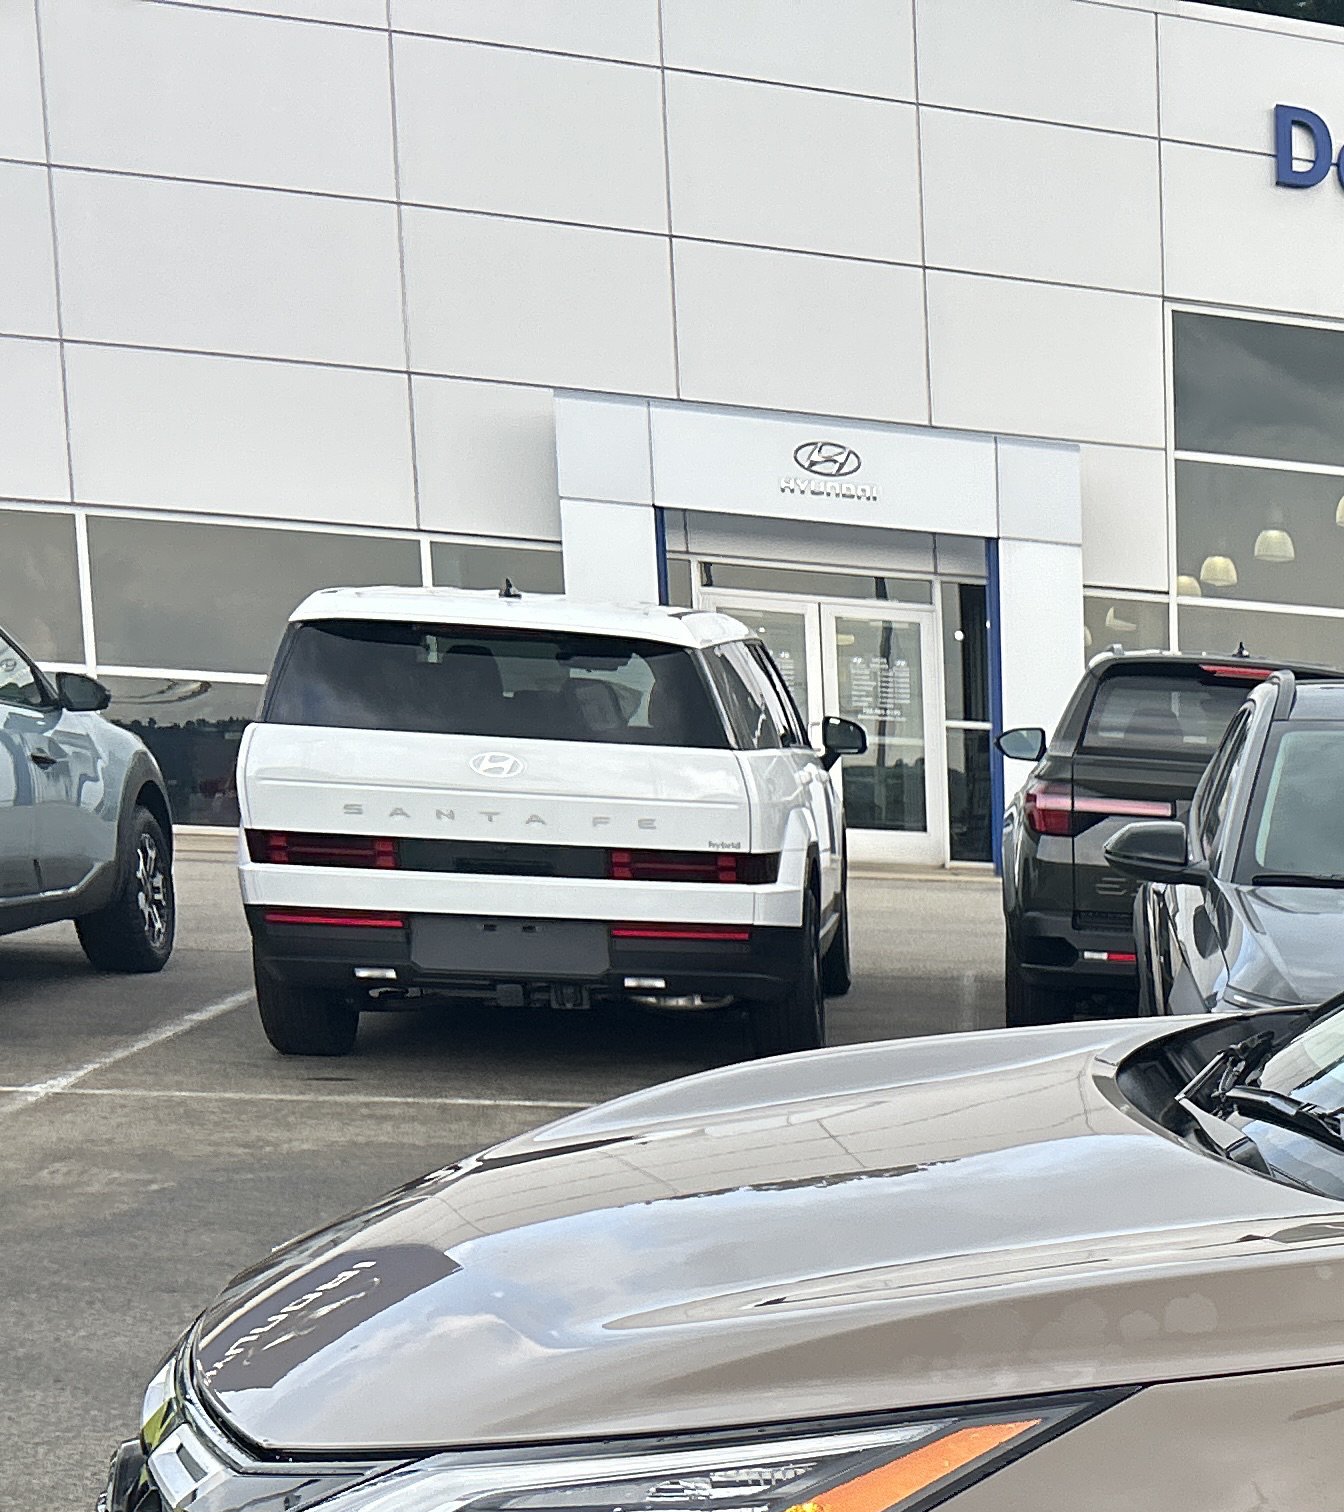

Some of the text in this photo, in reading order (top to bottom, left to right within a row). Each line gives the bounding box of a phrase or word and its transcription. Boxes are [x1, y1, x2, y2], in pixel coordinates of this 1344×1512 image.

[780, 477, 880, 502] HYUNDAI
[343, 802, 657, 831] SANTA FE
